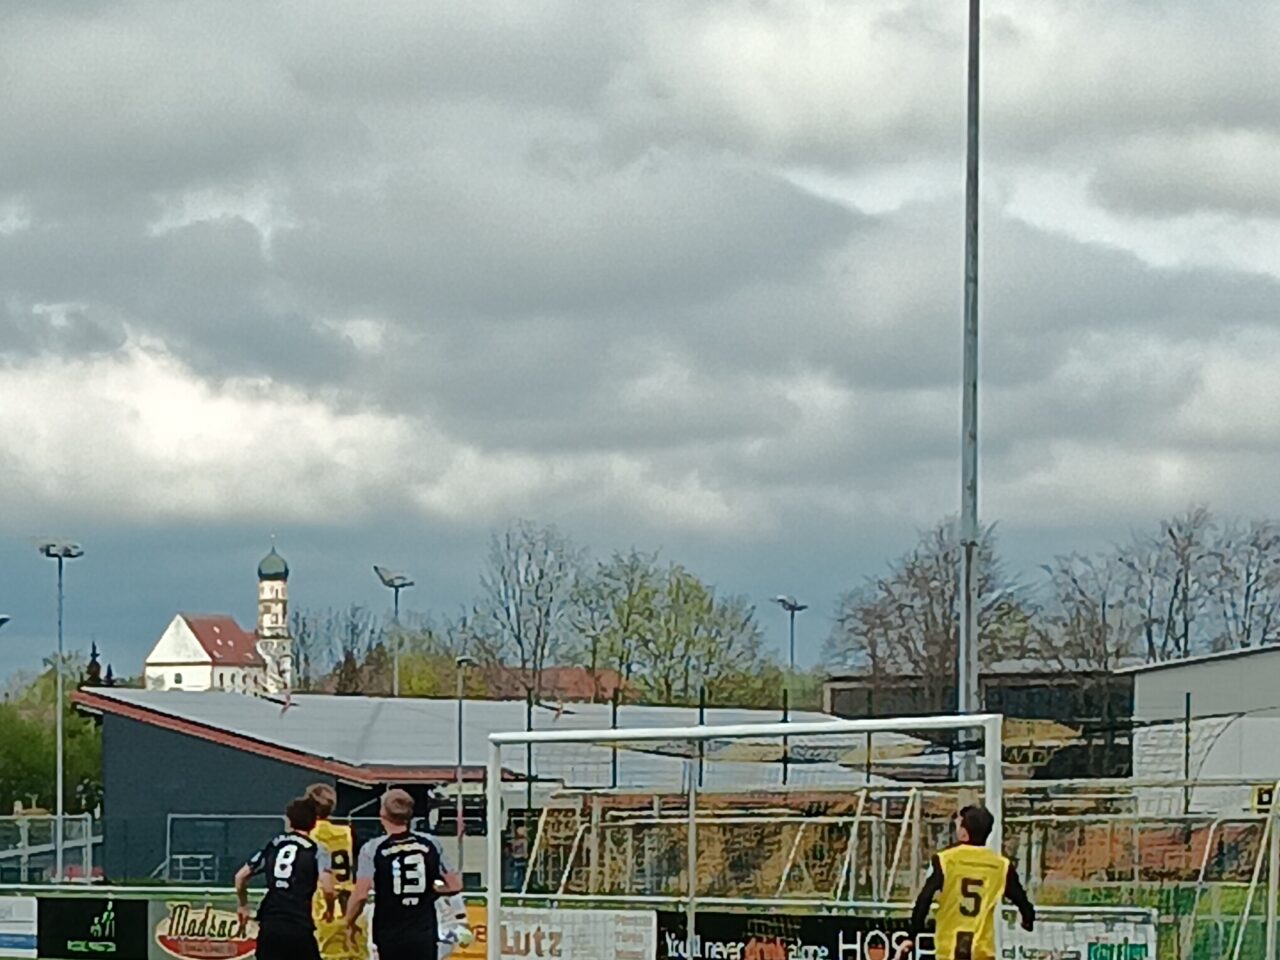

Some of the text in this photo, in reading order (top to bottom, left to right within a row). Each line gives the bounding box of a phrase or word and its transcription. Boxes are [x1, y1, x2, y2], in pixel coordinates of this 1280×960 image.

[274, 844, 298, 879] 8
[331, 849, 351, 882] 9
[391, 852, 427, 895] 13
[959, 877, 984, 917] 5
